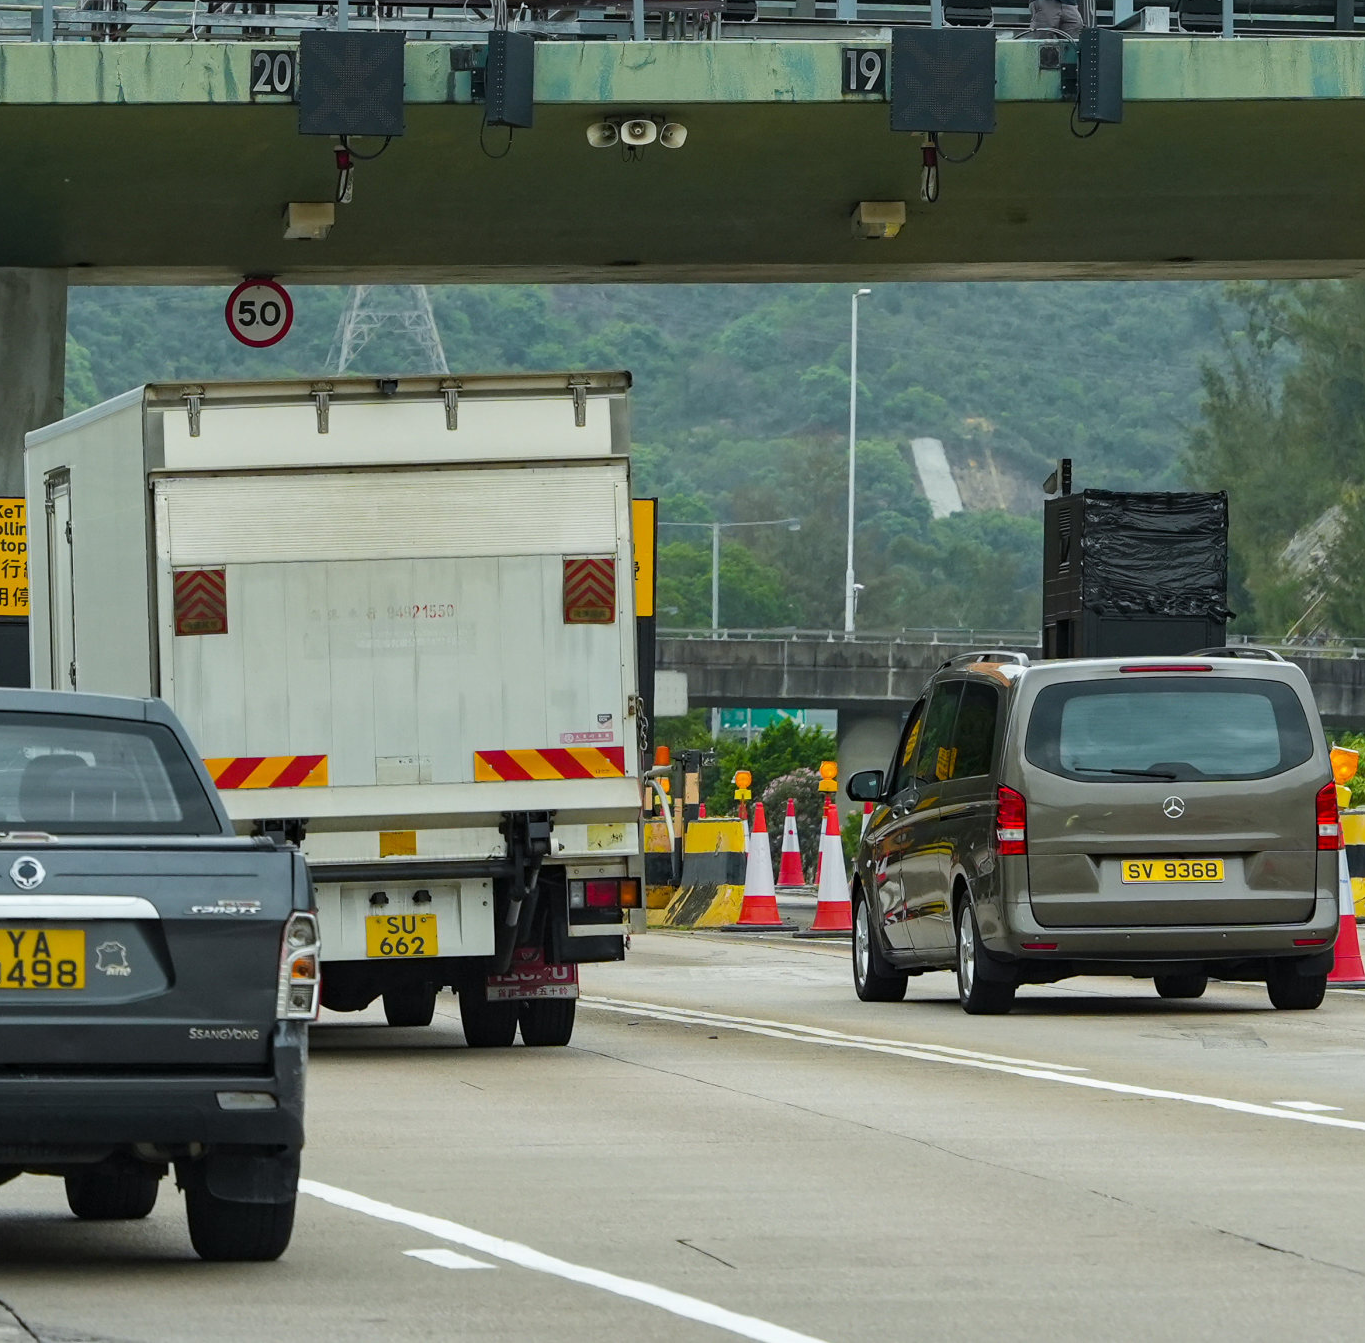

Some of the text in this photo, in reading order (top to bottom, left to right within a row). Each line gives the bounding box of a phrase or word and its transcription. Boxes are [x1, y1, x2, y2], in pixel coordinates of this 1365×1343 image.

[252, 52, 292, 92] 20
[846, 50, 882, 90] 19
[238, 300, 281, 327] 50
[1128, 862, 1218, 879] SV 9368
[386, 916, 417, 935] SU
[7, 931, 52, 958] YA
[379, 936, 425, 955] 662
